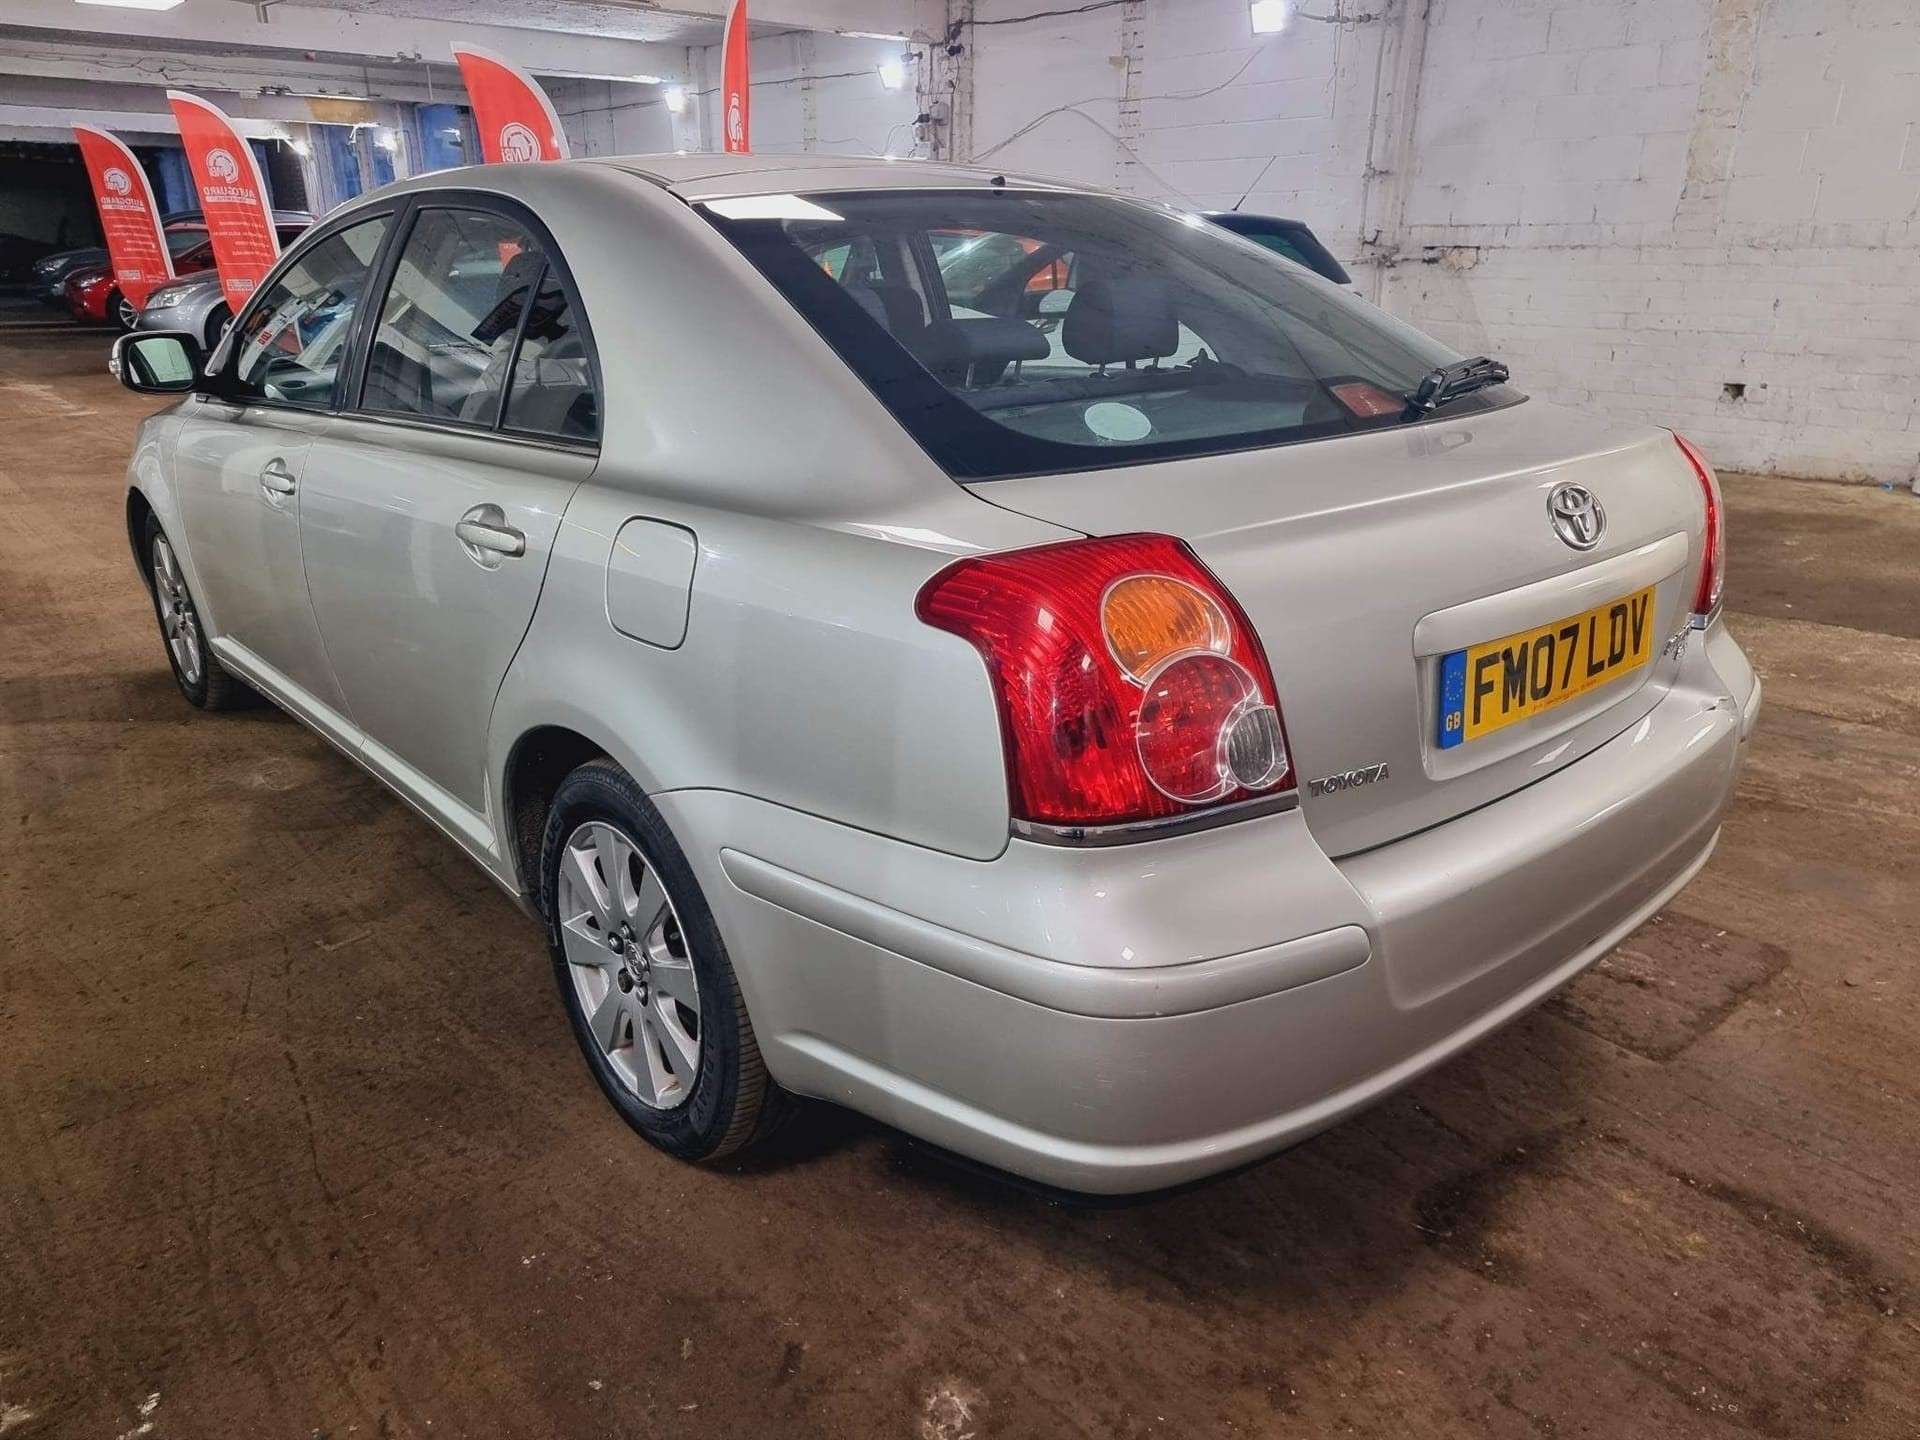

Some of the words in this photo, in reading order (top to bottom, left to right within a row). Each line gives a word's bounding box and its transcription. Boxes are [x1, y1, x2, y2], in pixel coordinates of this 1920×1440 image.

[1473, 622, 1580, 726] FM07
[1587, 593, 1648, 679] LDV
[1445, 711, 1461, 732] GB
[1308, 762, 1389, 798] TOYOTA
